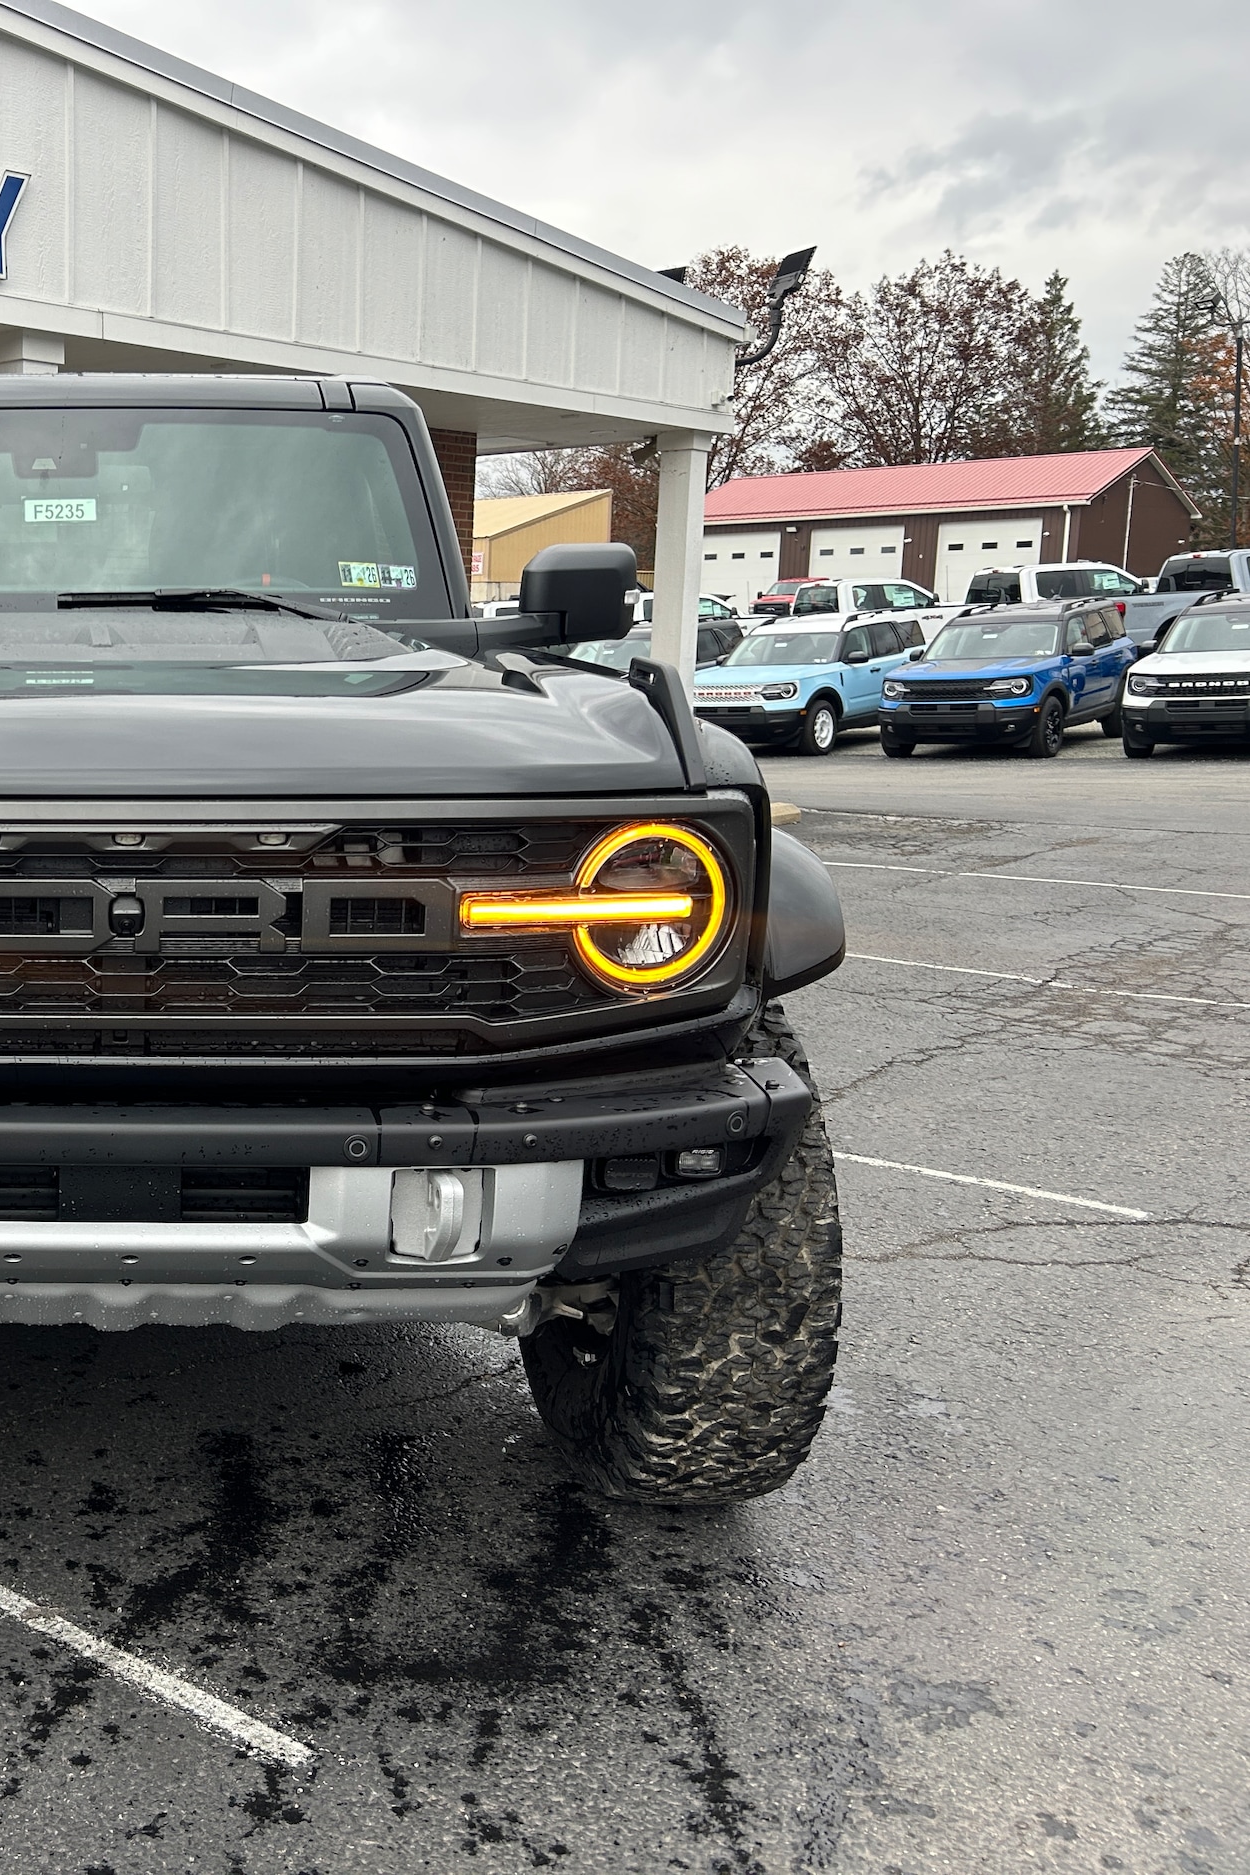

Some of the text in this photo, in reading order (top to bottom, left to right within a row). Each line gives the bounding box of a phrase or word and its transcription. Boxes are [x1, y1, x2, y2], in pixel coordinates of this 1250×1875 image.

[34, 504, 84, 519] F5235
[366, 567, 377, 582] 26
[404, 569, 416, 586] 26
[1168, 680, 1250, 688] BRONCO
